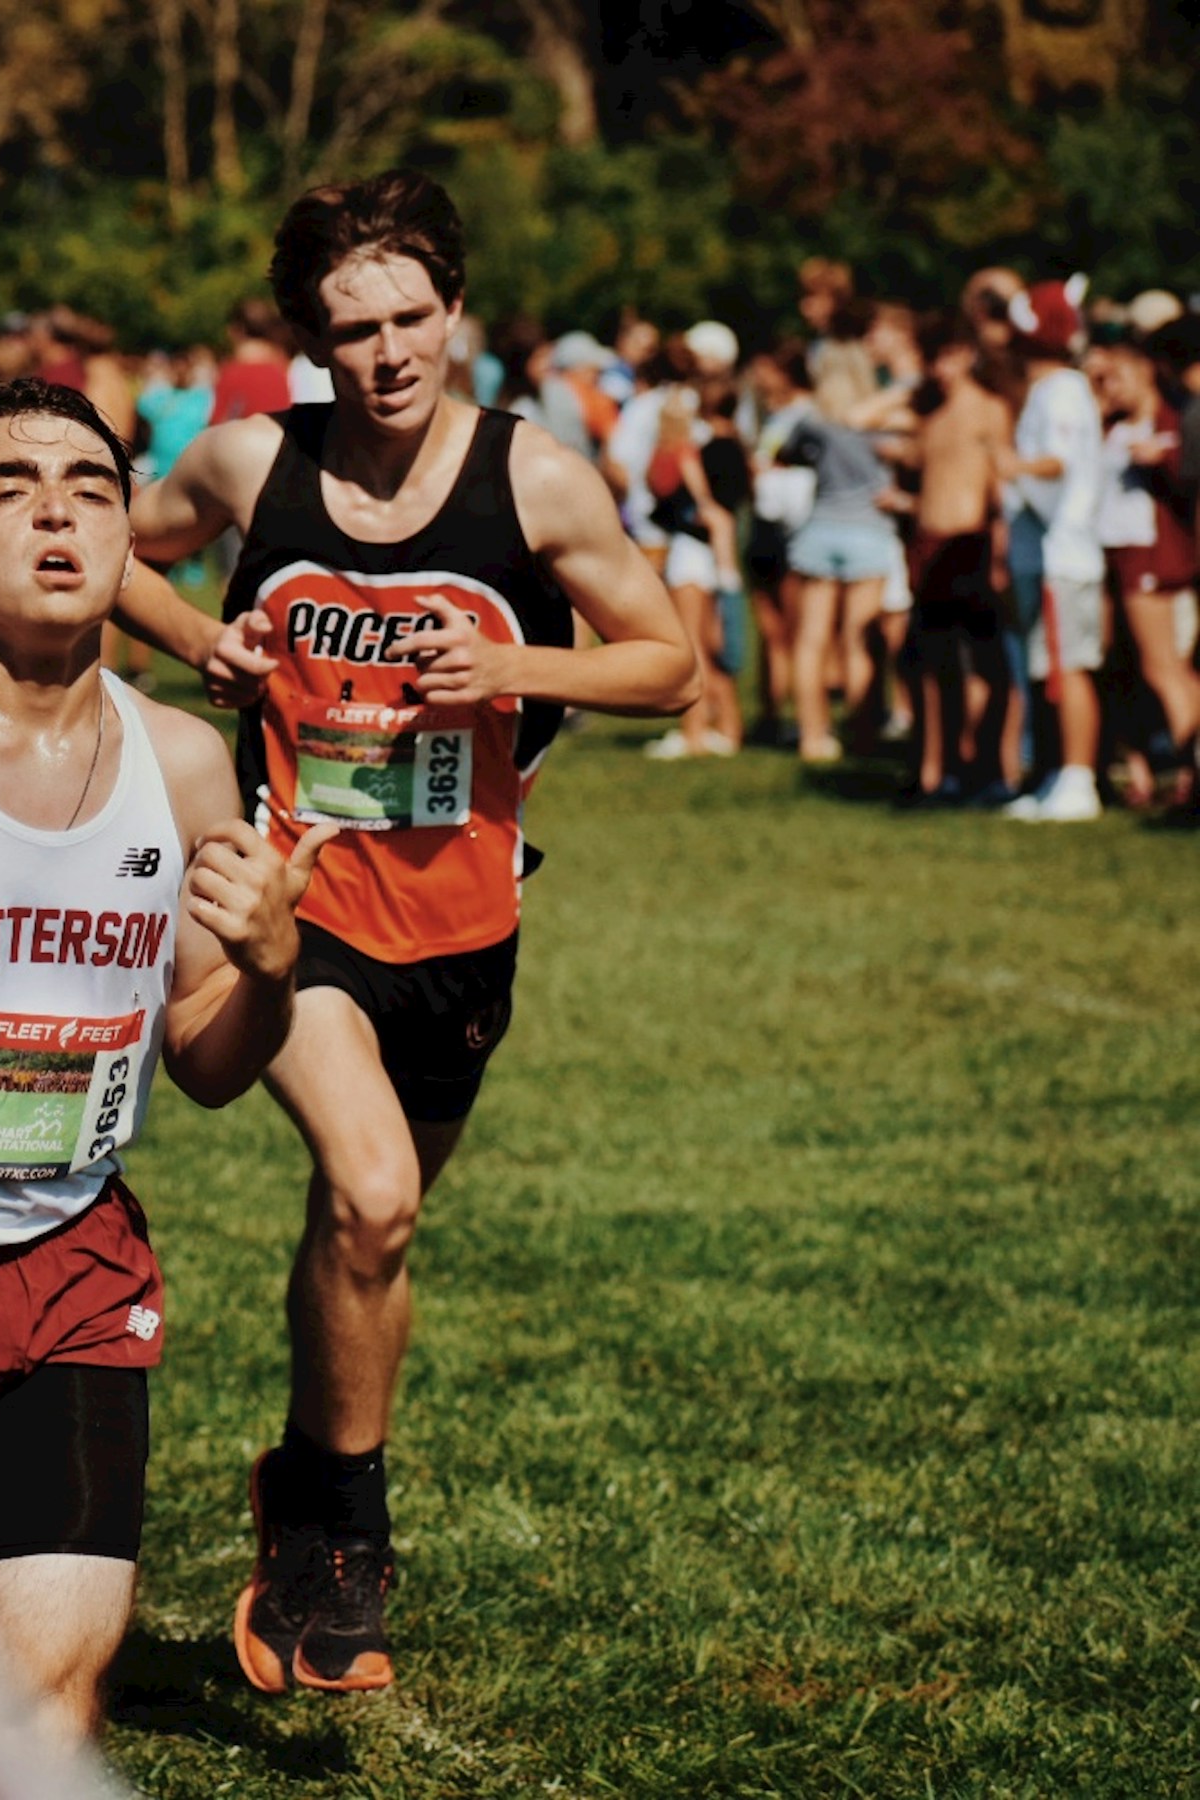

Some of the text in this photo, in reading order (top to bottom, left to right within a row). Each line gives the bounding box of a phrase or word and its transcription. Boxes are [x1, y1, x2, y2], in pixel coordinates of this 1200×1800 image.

[287, 599, 480, 664] PACE
[427, 734, 461, 814] 3632
[78, 1024, 123, 1043] FEET
[88, 1056, 129, 1160] 3653
